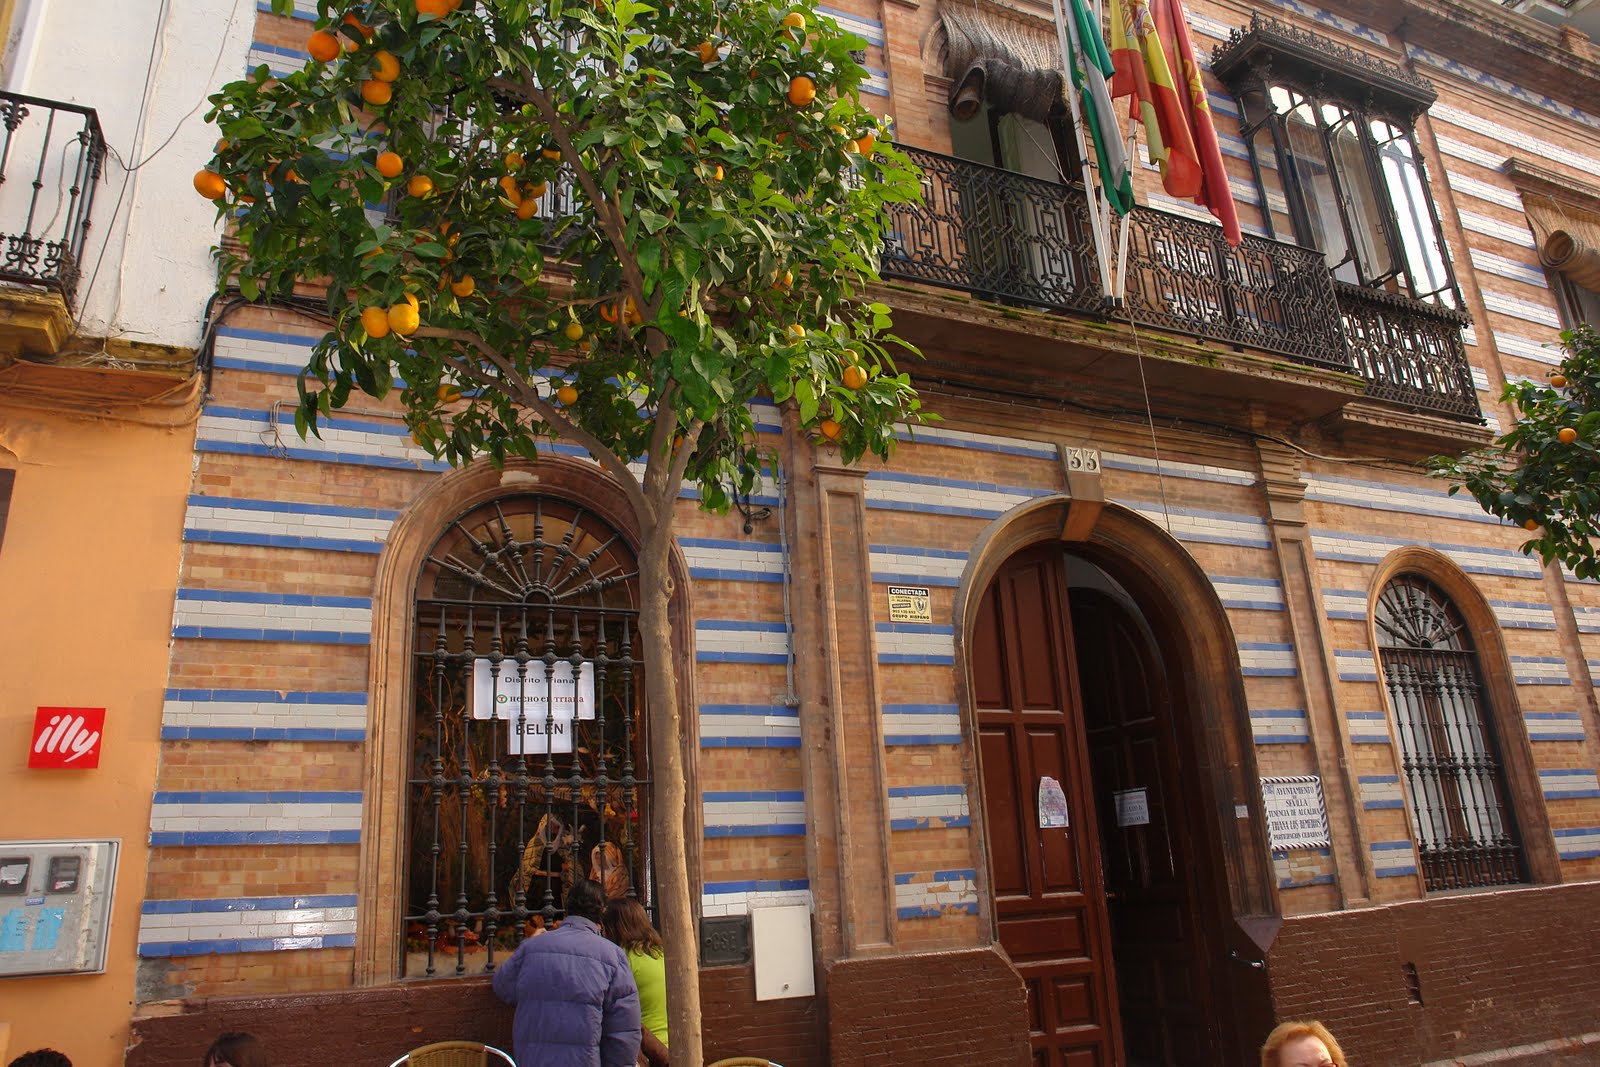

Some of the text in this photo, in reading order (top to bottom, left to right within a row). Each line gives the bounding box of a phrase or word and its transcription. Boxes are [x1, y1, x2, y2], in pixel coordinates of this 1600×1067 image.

[1069, 449, 1097, 470] 33
[891, 588, 927, 596] CONECTADA
[34, 714, 100, 763] illy
[1276, 786, 1315, 796] AYUNTAMIENTO
[1286, 799, 1308, 807] SEVILLA
[1268, 809, 1290, 818] TENENCIA
